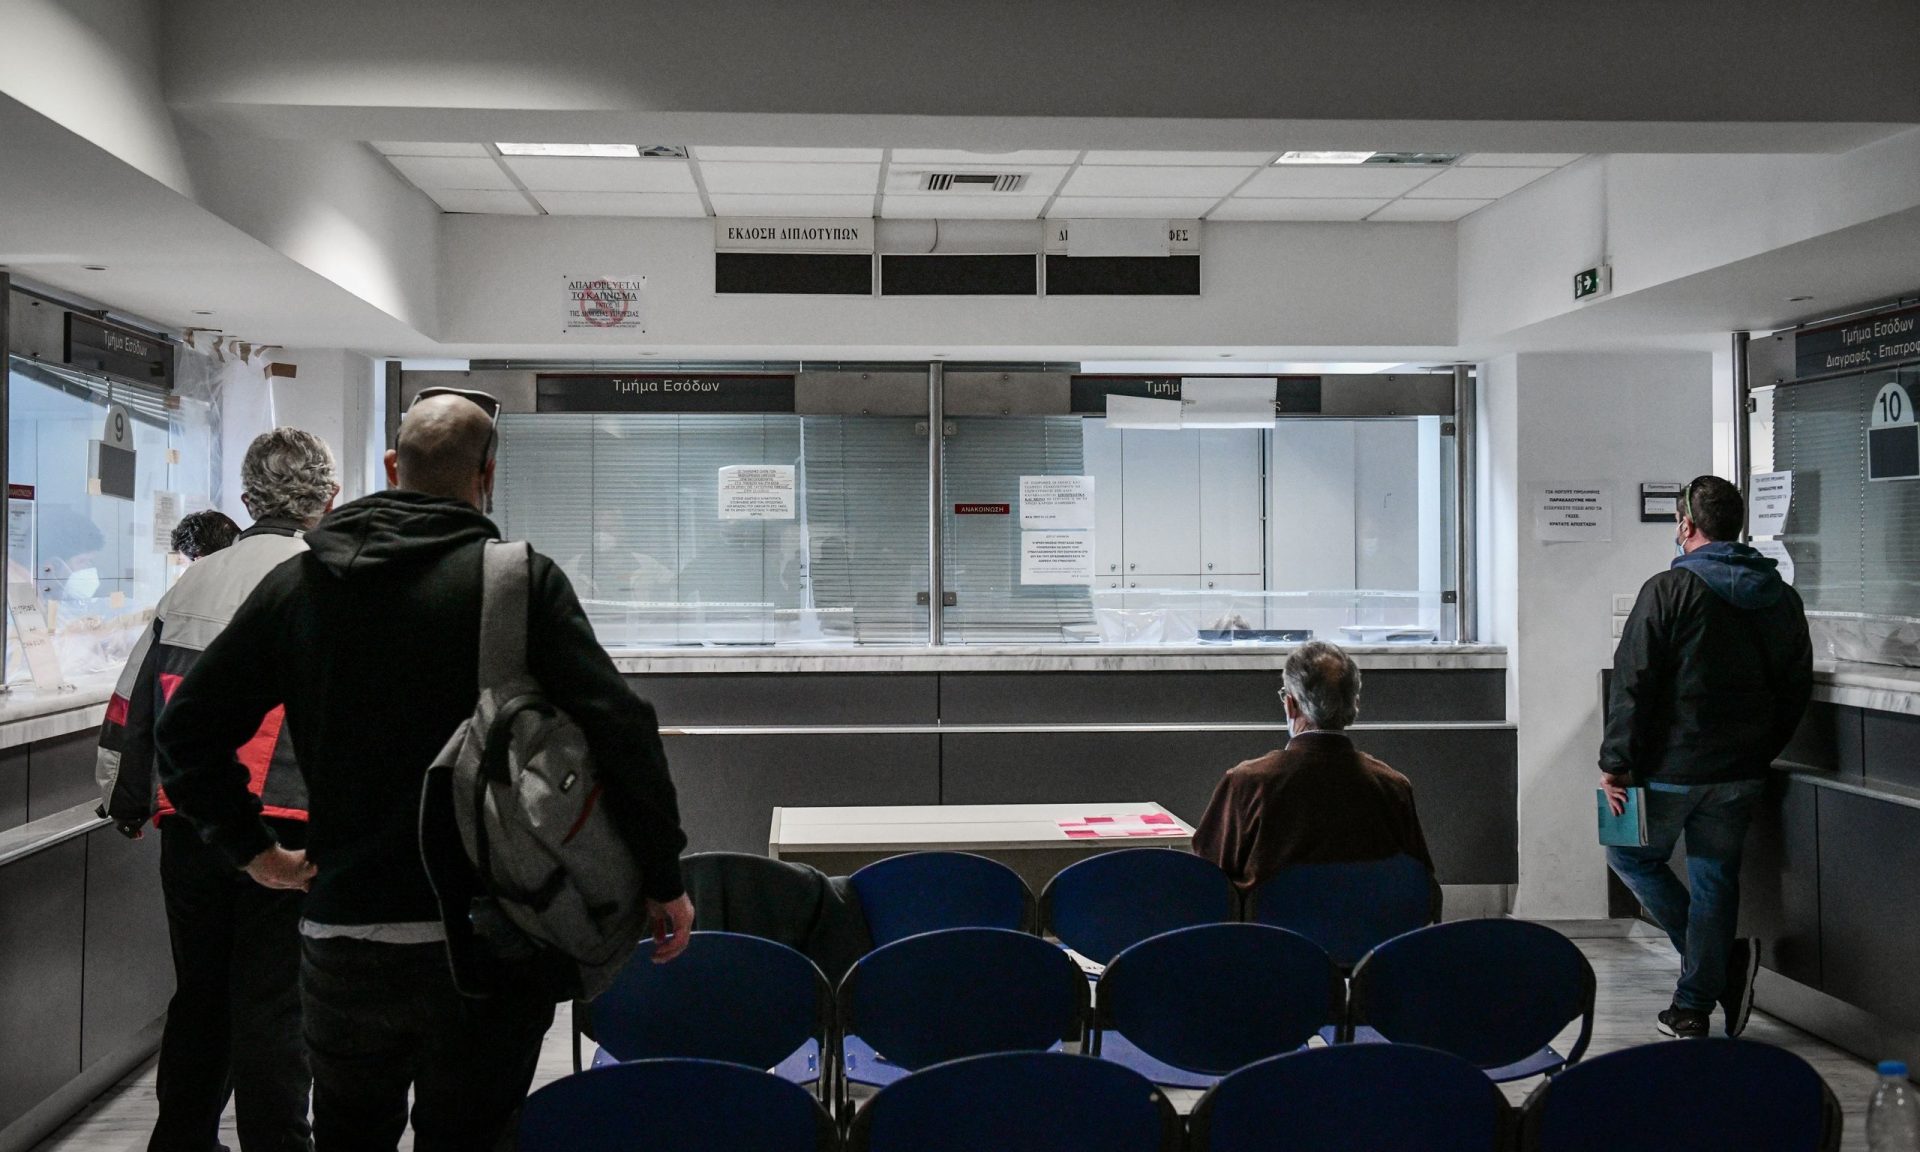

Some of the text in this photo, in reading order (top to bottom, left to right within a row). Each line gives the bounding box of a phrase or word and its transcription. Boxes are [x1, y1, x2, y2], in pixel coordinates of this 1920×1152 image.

[728, 227, 859, 240] ΕΚΔΟΣΗ ΔΙΠΛΟΤΥΠΩΝ
[568, 281, 641, 290] ΑΠΑΓΟΡΕΥΕΤΑΙ
[572, 292, 585, 301] ΤΟ
[1841, 317, 1914, 346] Τμήμα Εσόδων
[103, 330, 124, 352] Τμήμα
[1826, 347, 1872, 368] Διαγραφές
[613, 379, 721, 394] Τμήμα Εσόδων
[1145, 380, 1181, 395] Τμήμ
[1879, 390, 1902, 422] 10
[115, 413, 124, 443] 9
